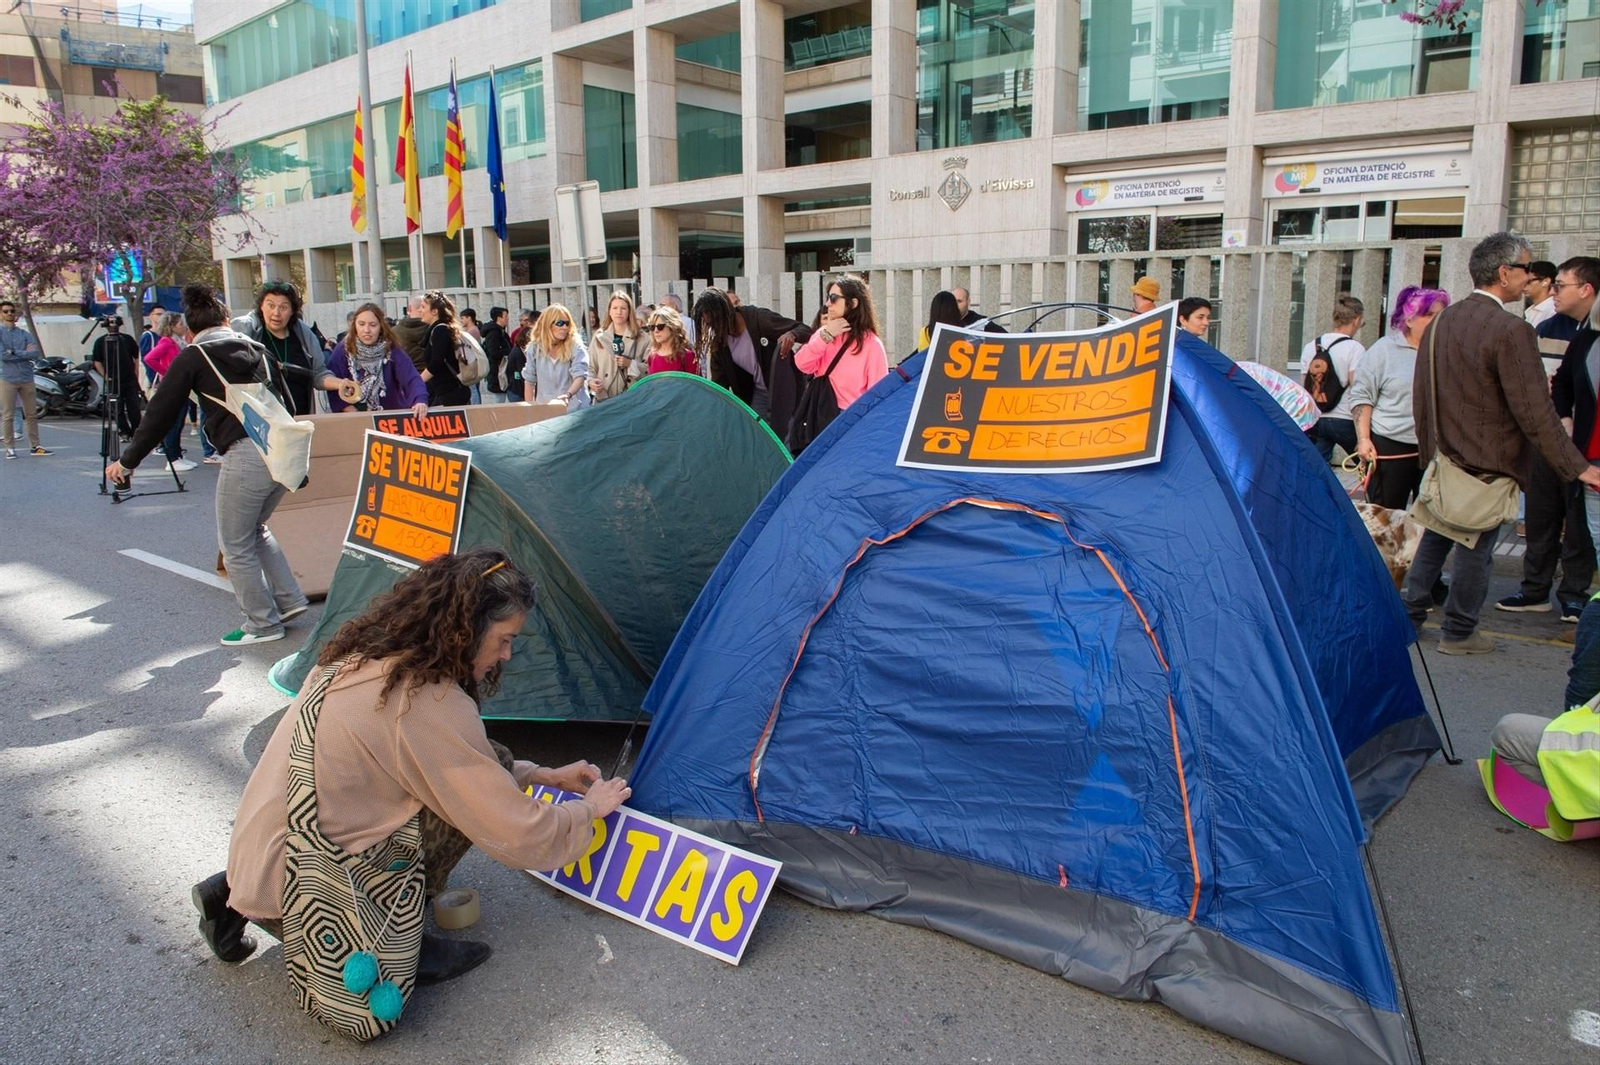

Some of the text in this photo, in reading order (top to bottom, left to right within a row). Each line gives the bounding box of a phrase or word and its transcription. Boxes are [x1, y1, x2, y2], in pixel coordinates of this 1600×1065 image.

[1323, 161, 1407, 176] OFICINA D'ATENCIÓ
[1377, 173, 1389, 181] DE
[1391, 169, 1435, 180] REGISTRE
[889, 177, 1034, 202] Consell d'Eivissa
[1114, 178, 1182, 192] OFICINA D'ATENCIÓ
[1169, 186, 1205, 196] REGISTRE
[944, 319, 1163, 380] SE VENDE
[997, 386, 1128, 416] NUESTROS
[378, 415, 466, 438] SE ALQUILA
[987, 423, 1127, 450] DERECHOS
[368, 441, 462, 497] SE VENDE
